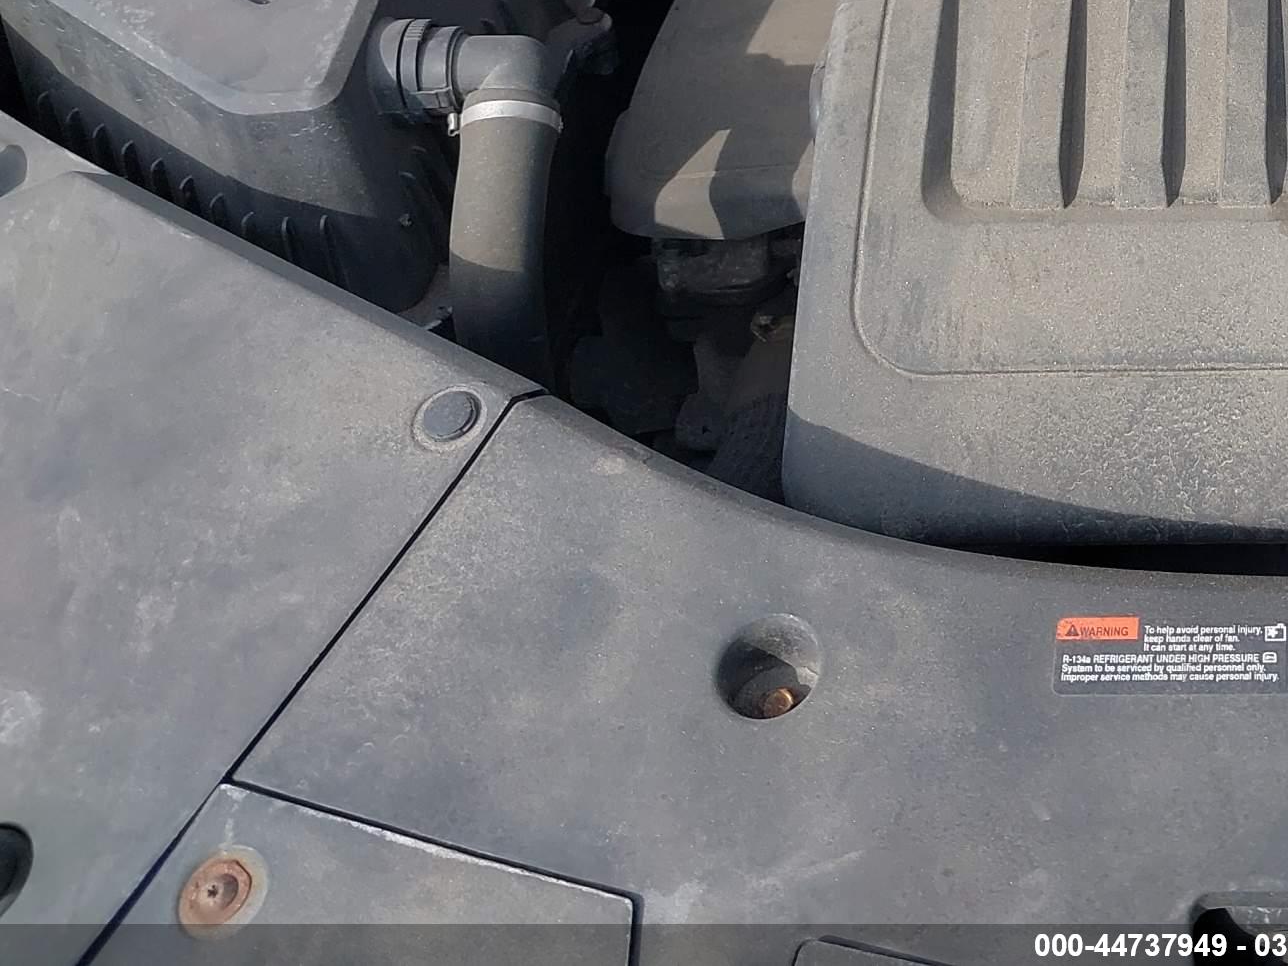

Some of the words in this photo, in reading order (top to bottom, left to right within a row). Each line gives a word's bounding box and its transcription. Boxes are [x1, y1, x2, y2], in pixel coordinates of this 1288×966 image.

[1080, 626, 1129, 636] WARNING
[1156, 625, 1174, 635] help
[1176, 625, 1198, 633] avoid
[1200, 625, 1235, 635] personal
[1144, 634, 1164, 644] keep
[1166, 634, 1191, 642] hands
[1193, 634, 1212, 642] clear
[1225, 634, 1240, 642] fan.
[1168, 643, 1187, 651] start
[1198, 645, 1214, 653] any
[1216, 643, 1236, 651] time.
[1063, 655, 1091, 663] R-134a
[1093, 655, 1154, 663] REFRIGERANT
[1156, 655, 1186, 663] UNDER
[1188, 655, 1210, 663] HIGH
[1212, 655, 1260, 663] PRESSURE
[1061, 664, 1092, 674] System
[1117, 664, 1152, 672] serviced
[1166, 664, 1201, 673] qualified
[1204, 663, 1244, 673] personnel
[1246, 663, 1266, 673] only.
[1061, 673, 1098, 683] Improper
[1100, 673, 1130, 681] service
[1170, 674, 1187, 682] may
[1216, 672, 1252, 682] personal
[1254, 672, 1280, 682] injury.
